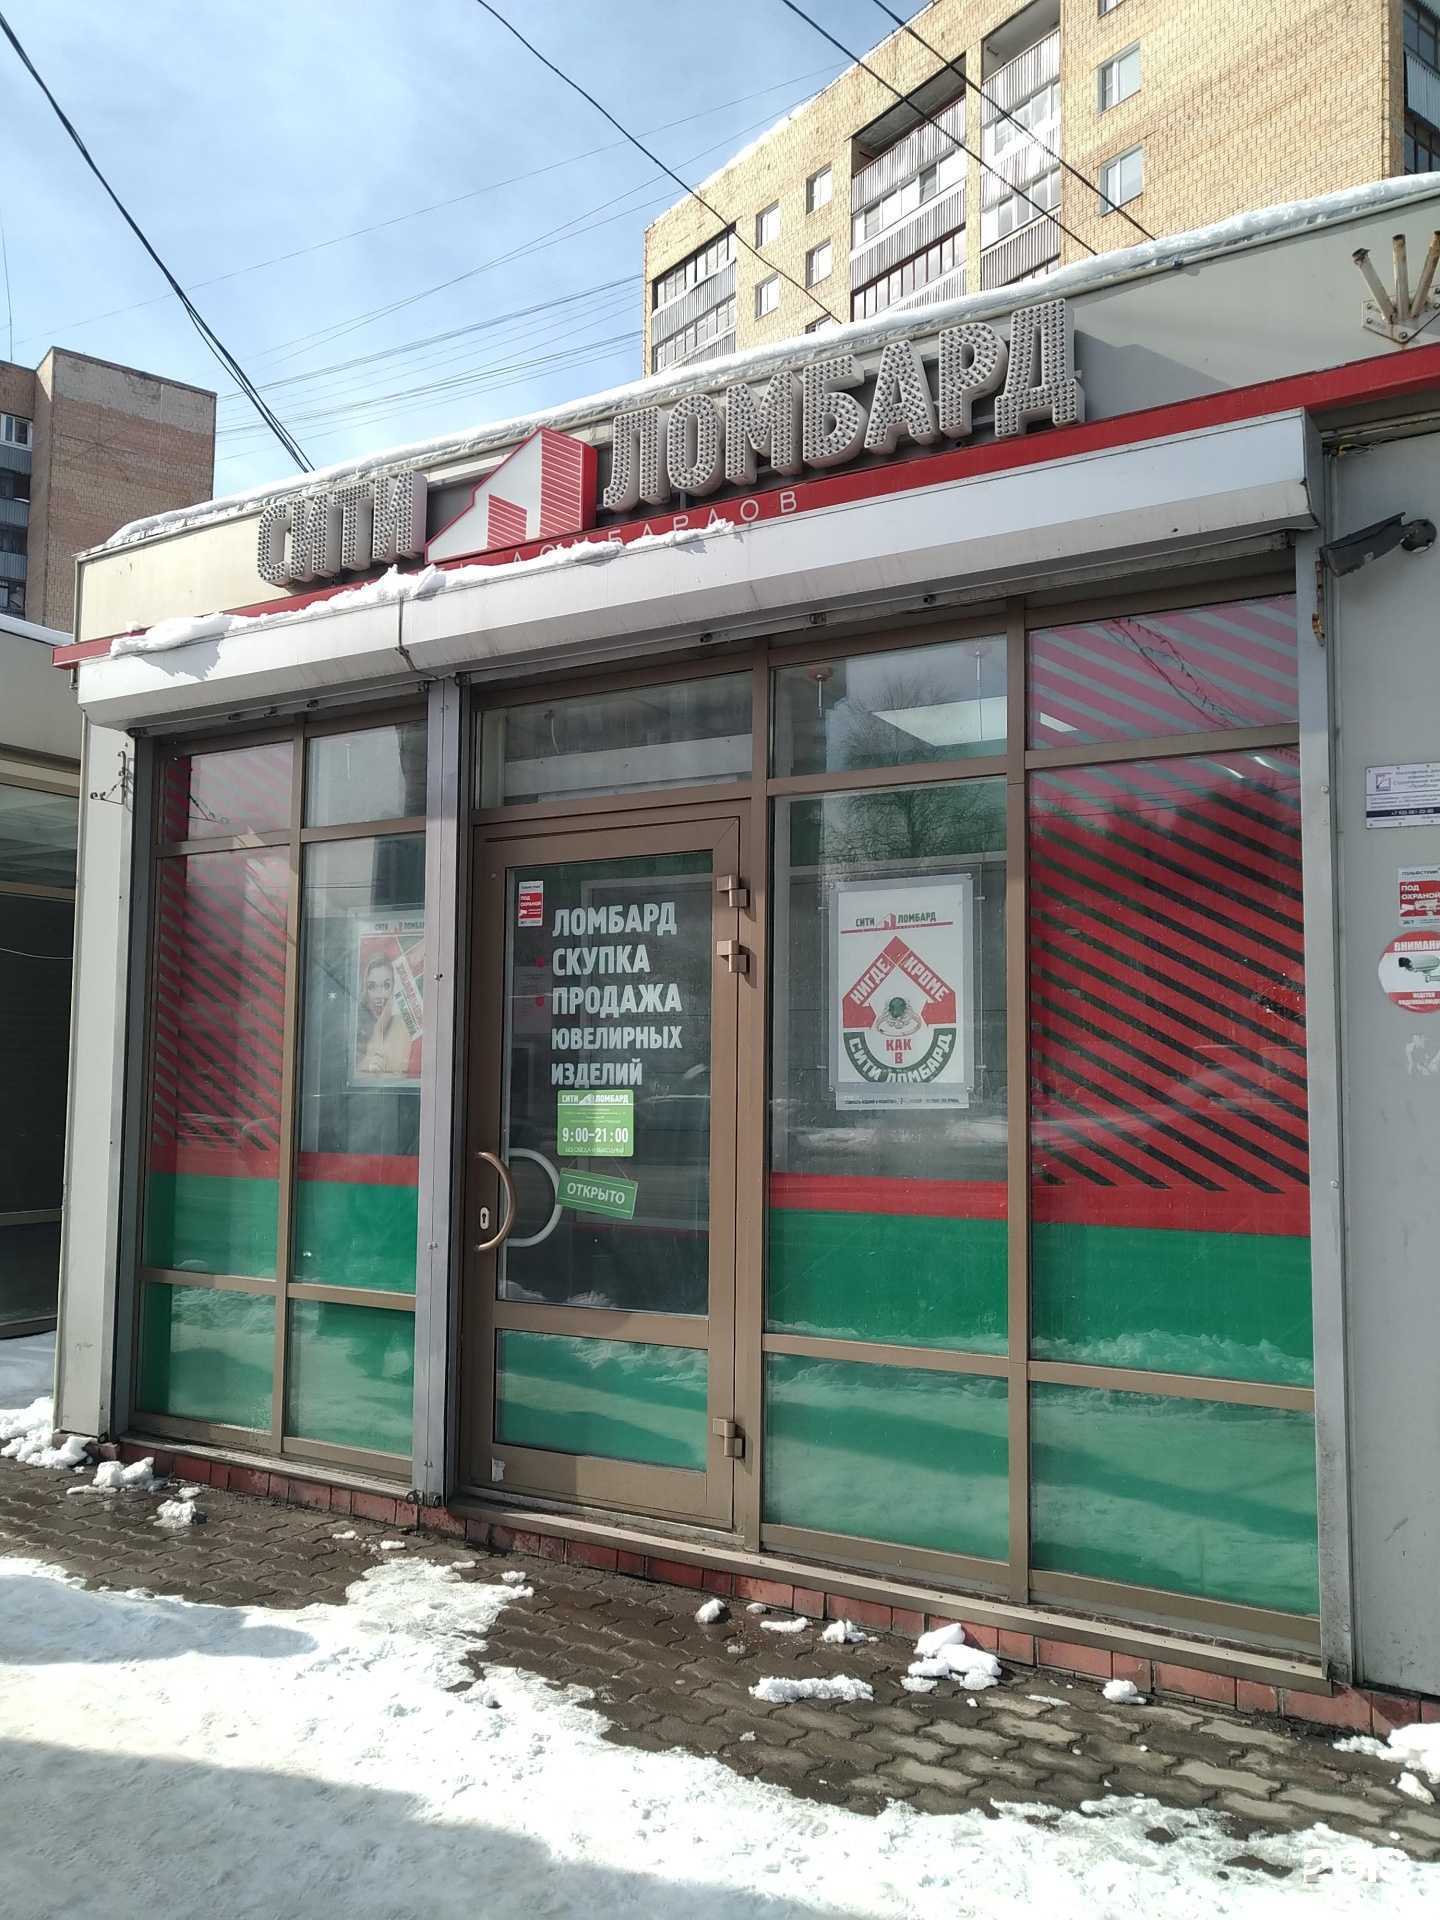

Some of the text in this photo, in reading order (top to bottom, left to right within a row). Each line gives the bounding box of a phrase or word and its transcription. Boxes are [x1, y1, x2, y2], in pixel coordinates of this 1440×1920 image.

[257, 298, 1084, 583] СИТИ ЛОМБАРД
[552, 902, 677, 936] ЛОМБАРД
[855, 911, 937, 927] СИТИ ЛОМБАРД
[552, 944, 651, 976] СКУПКА
[850, 955, 950, 1005] НИГДЕ КРОМЕ
[552, 983, 683, 1018] ПРОДАЖА
[551, 1026, 683, 1050] ЮВЕЛИРНЫХ
[886, 1039, 912, 1051] КАК
[551, 1058, 643, 1088] ИЗДЕЛИЙ
[849, 1033, 953, 1083] СИТИ ЛОМБАРД
[895, 1052, 903, 1064] В
[562, 1127, 629, 1142] 9:00-21:00
[567, 1182, 625, 1204] ОТКРЫТО
